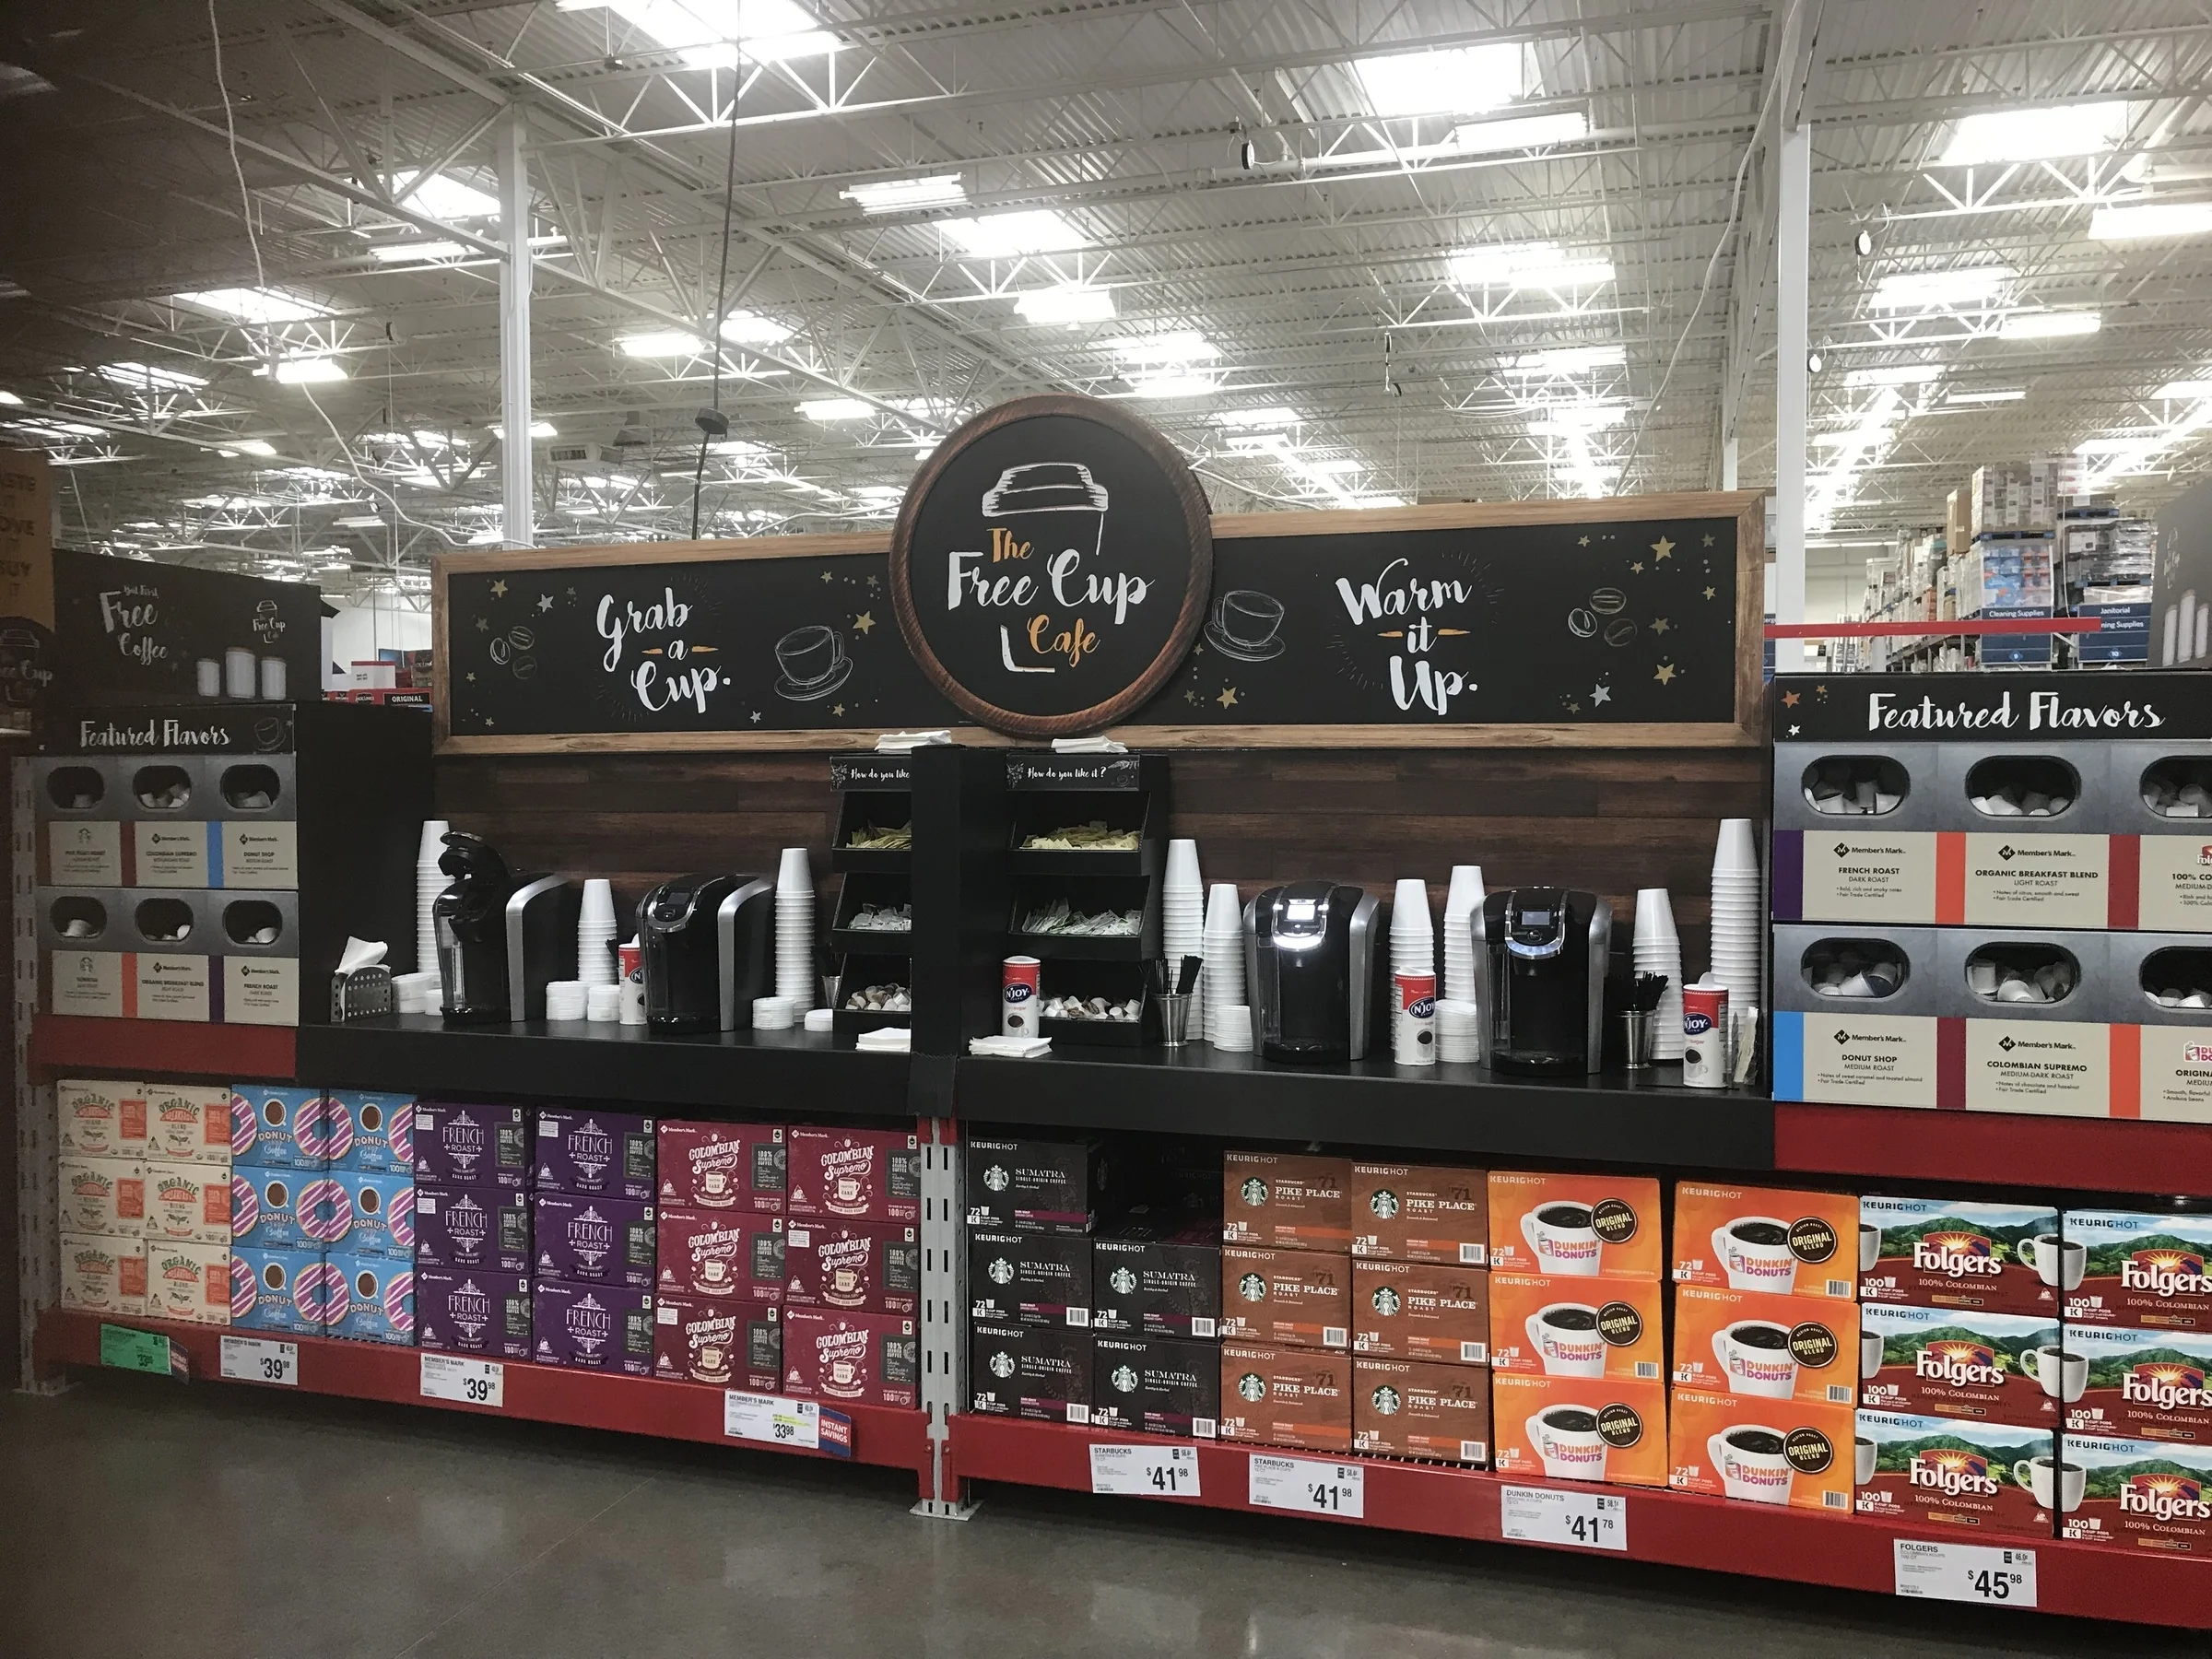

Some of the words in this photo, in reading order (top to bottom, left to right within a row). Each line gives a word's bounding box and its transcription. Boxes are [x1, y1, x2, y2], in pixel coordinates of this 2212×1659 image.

[987, 528, 1035, 562] The
[947, 551, 1039, 610] Free
[1047, 548, 1155, 625] Cup
[1335, 558, 1473, 626] Warm
[100, 591, 159, 633] Free
[1989, 610, 2017, 618] Cleaning
[2100, 606, 2130, 615] Janitorial
[596, 587, 693, 672] Grab
[2116, 620, 2144, 629] Supplies
[1027, 614, 1100, 667] Cafe
[1406, 616, 1438, 653] it
[118, 632, 169, 665] Coffee
[667, 640, 689, 661] a
[630, 660, 732, 713] Cup.
[1389, 655, 1477, 715] Up.
[1868, 691, 2018, 731] Featured
[2030, 692, 2166, 731] Flavors
[80, 720, 161, 747] Featured
[163, 719, 231, 747] Flavors
[850, 768, 866, 779] How
[868, 770, 878, 779] do
[880, 771, 893, 781] you
[895, 769, 910, 779] like
[1028, 768, 1044, 779] How
[1046, 769, 1056, 779] do
[1058, 771, 1072, 781] you
[1074, 769, 1089, 779] like
[1852, 846, 1884, 854] Member's
[1975, 869, 2017, 877] ORGANIC
[2018, 870, 2067, 878] BREAKFAST
[1852, 1034, 1884, 1042] Member's
[2018, 1041, 2053, 1049] Member's
[1987, 1061, 2041, 1070] COLOMBIAN
[2043, 1063, 2088, 1072] SUPREMO
[2176, 1069, 2212, 1077] ORIGINA
[2000, 1071, 2050, 1079] MEDIUM-DARK
[159, 1097, 201, 1116] ORGANIC
[258, 1131, 293, 1144] DONUT
[354, 1135, 388, 1149] DONUT
[443, 1126, 485, 1145] FRENCH
[451, 1144, 476, 1153] ROAST
[568, 1135, 613, 1154] FRENCH
[576, 1152, 603, 1162] ROAST
[692, 1154, 737, 1174] Supremo
[1015, 1168, 1066, 1179] SUMATRA
[1275, 1186, 1302, 1196] PIKE
[1305, 1188, 1341, 1199] PLACE
[1406, 1199, 1435, 1209] PIKE
[1438, 1201, 1476, 1212] PLACE
[1594, 1212, 1633, 1229] ORIGINAL
[1605, 1222, 1626, 1233] BLEND
[1792, 1231, 1833, 1247] ORIGINAL
[1802, 1241, 1825, 1251] BLEND
[1554, 1248, 1597, 1260] DONUTS
[1913, 1241, 2002, 1278] Folgers
[1144, 1270, 1196, 1282] SUMATRA
[1746, 1265, 1792, 1277] DONUTS
[1865, 1277, 1885, 1288] 100
[1919, 1277, 1944, 1288] 100%
[1946, 1280, 1997, 1291] COLOMBIAN
[2127, 1298, 2153, 1307] 100%
[2156, 1300, 2209, 1311] COLOMBIAN
[1916, 1350, 2005, 1387] Folgers
[728, 1394, 758, 1404] MEMBER'S
[820, 1418, 848, 1434] INSTANT
[820, 1427, 848, 1443] SAVINGS
[1254, 1458, 1294, 1468] STARBUCKS
[1506, 1489, 1534, 1499] DUNKIN
[1535, 1492, 1565, 1501] DONUTS
[1900, 1543, 1938, 1553] FOLGERS
